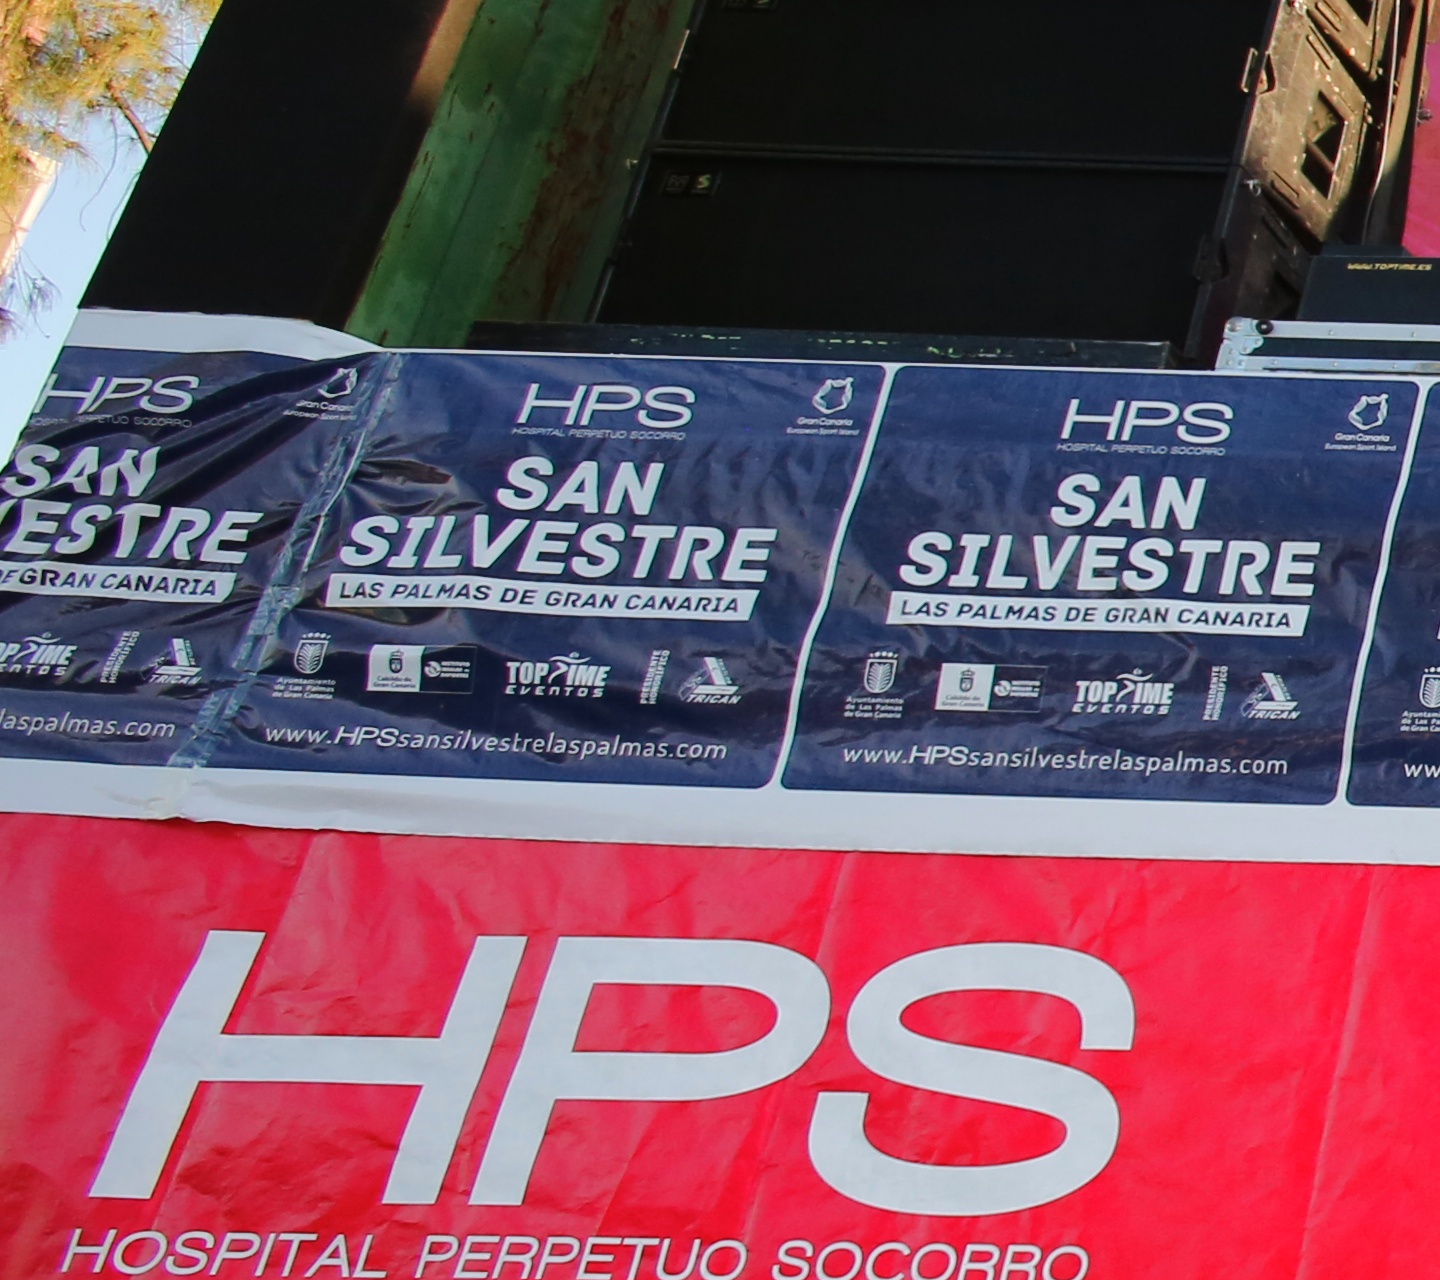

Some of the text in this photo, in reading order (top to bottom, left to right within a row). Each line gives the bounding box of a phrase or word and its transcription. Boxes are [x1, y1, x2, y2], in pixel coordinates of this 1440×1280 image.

[517, 382, 696, 430] HPS
[1060, 399, 1234, 444] HPS
[497, 455, 664, 516] SAN
[1050, 474, 1206, 530] SAN
[339, 515, 778, 583] SILVESTRE
[899, 532, 1321, 597] SILVESTRE
[265, 724, 728, 761] www.HPSsansilvestrelaspalmas.com
[88, 929, 1135, 1217] HPS
[61, 1228, 387, 1280] HOSPITAL
